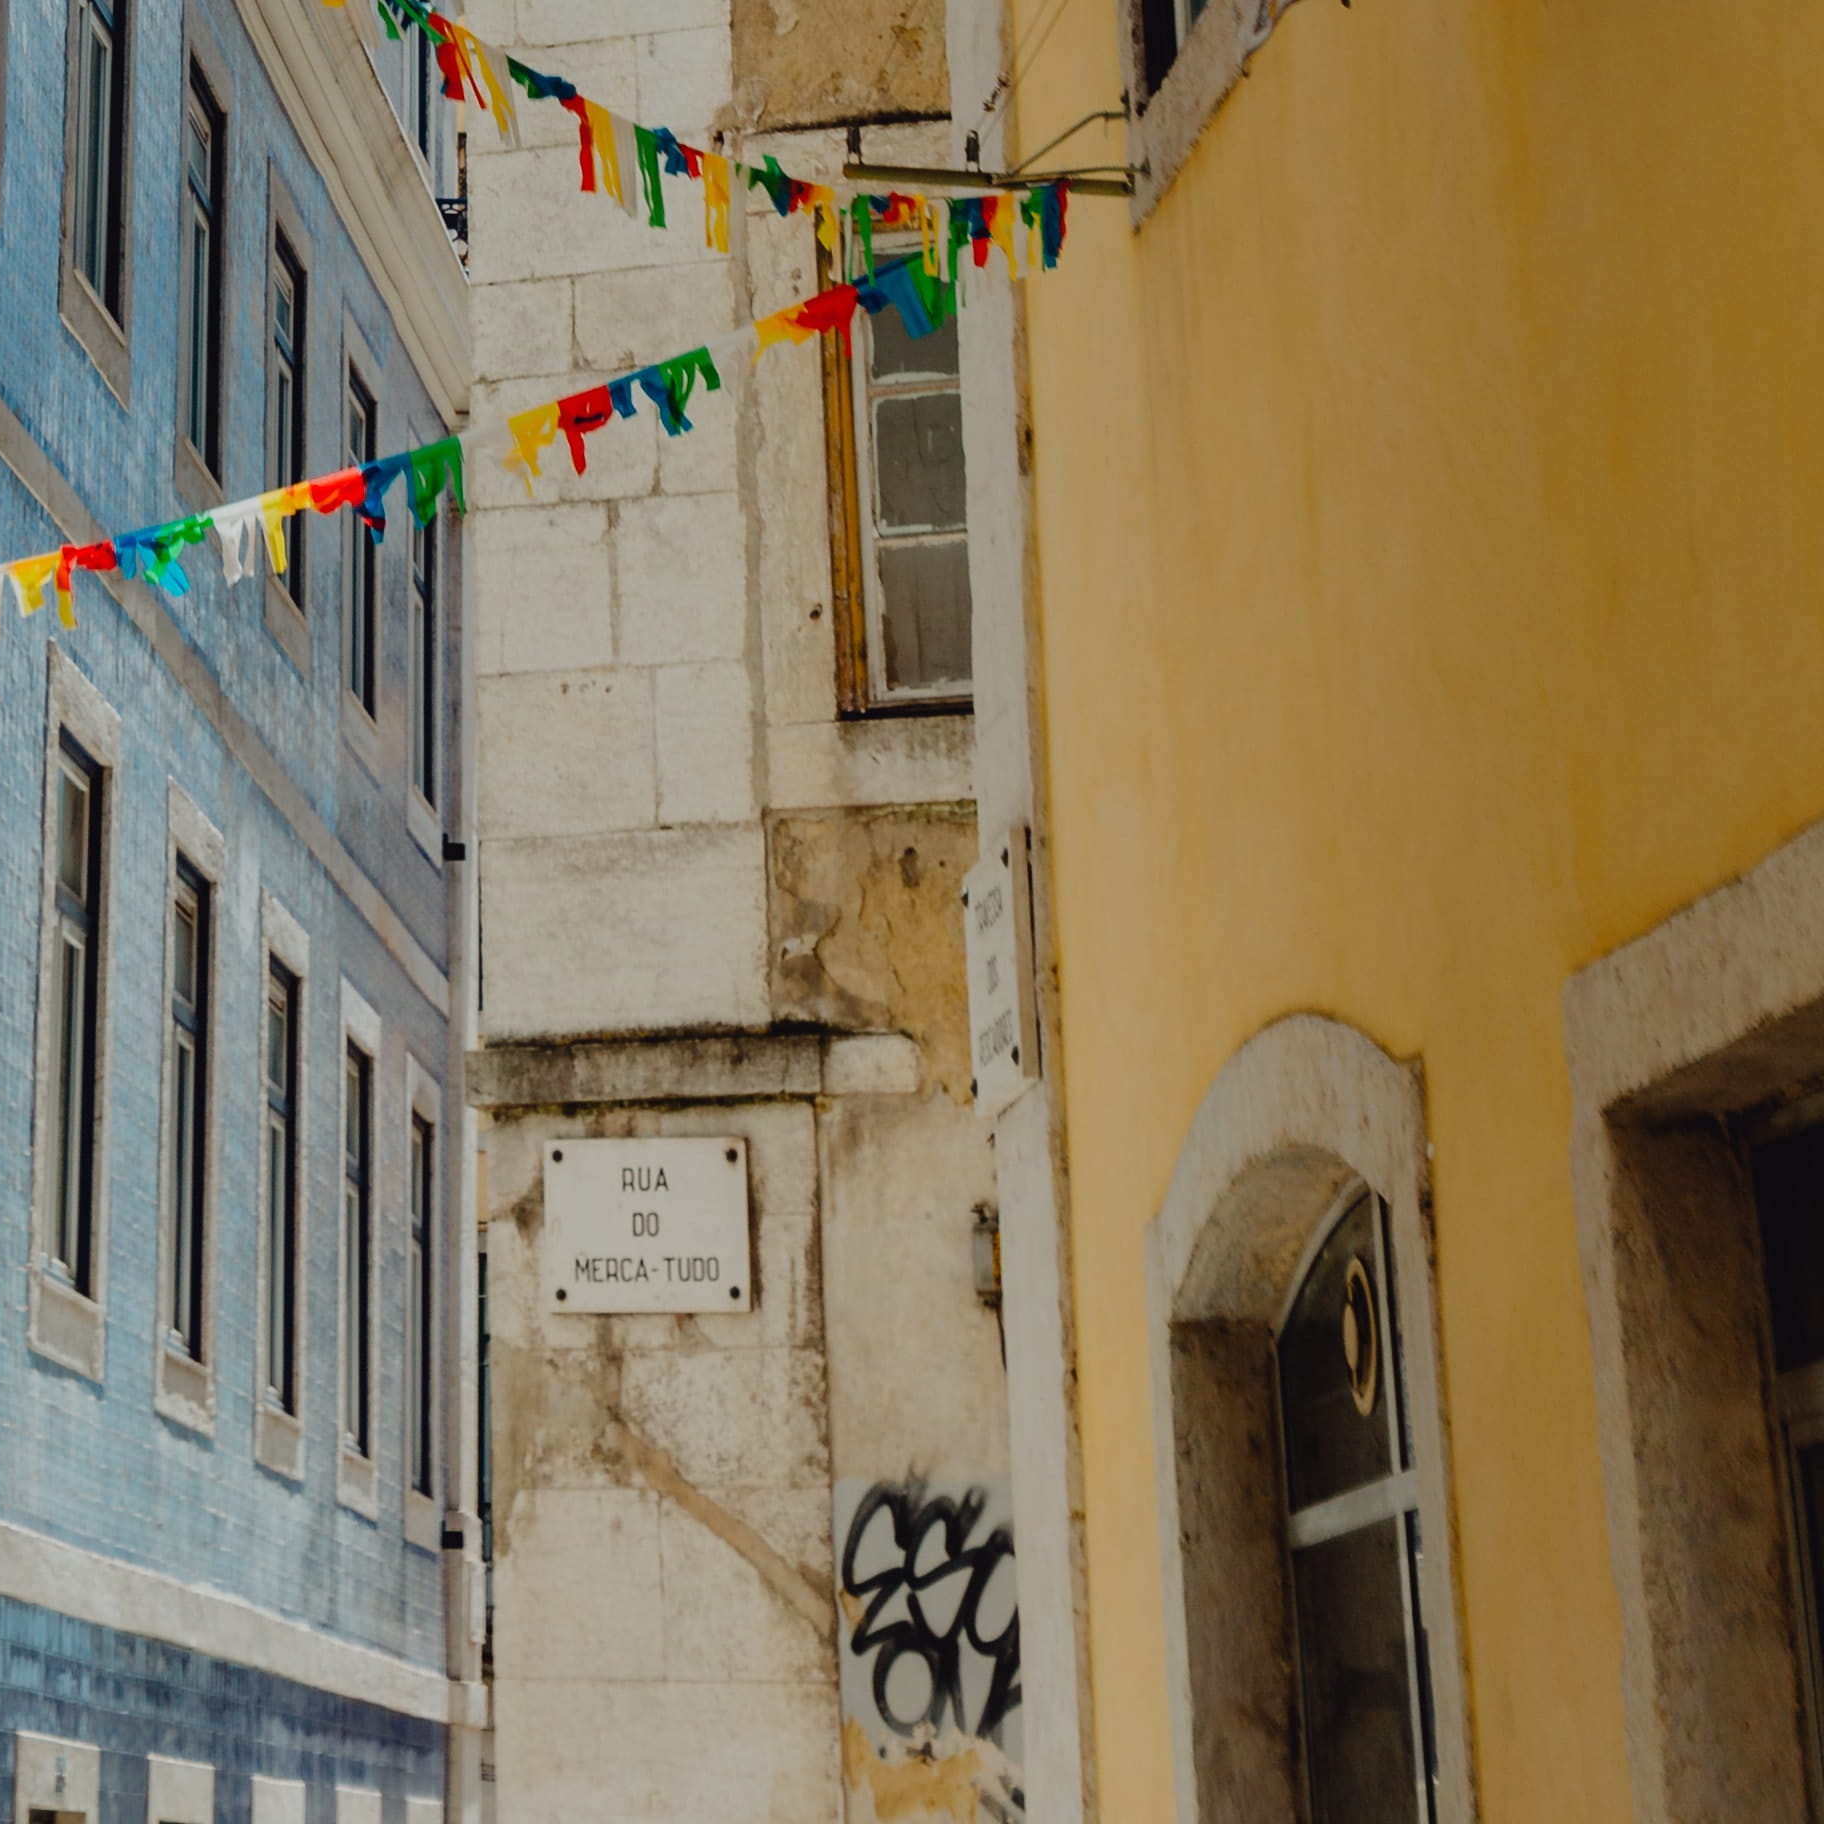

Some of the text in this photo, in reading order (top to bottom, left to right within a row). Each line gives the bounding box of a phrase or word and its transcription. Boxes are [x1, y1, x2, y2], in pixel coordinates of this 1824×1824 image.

[622, 1167, 669, 1192] RUA
[632, 1212, 660, 1237] DO
[575, 1257, 720, 1282] MERCA-TUDO
